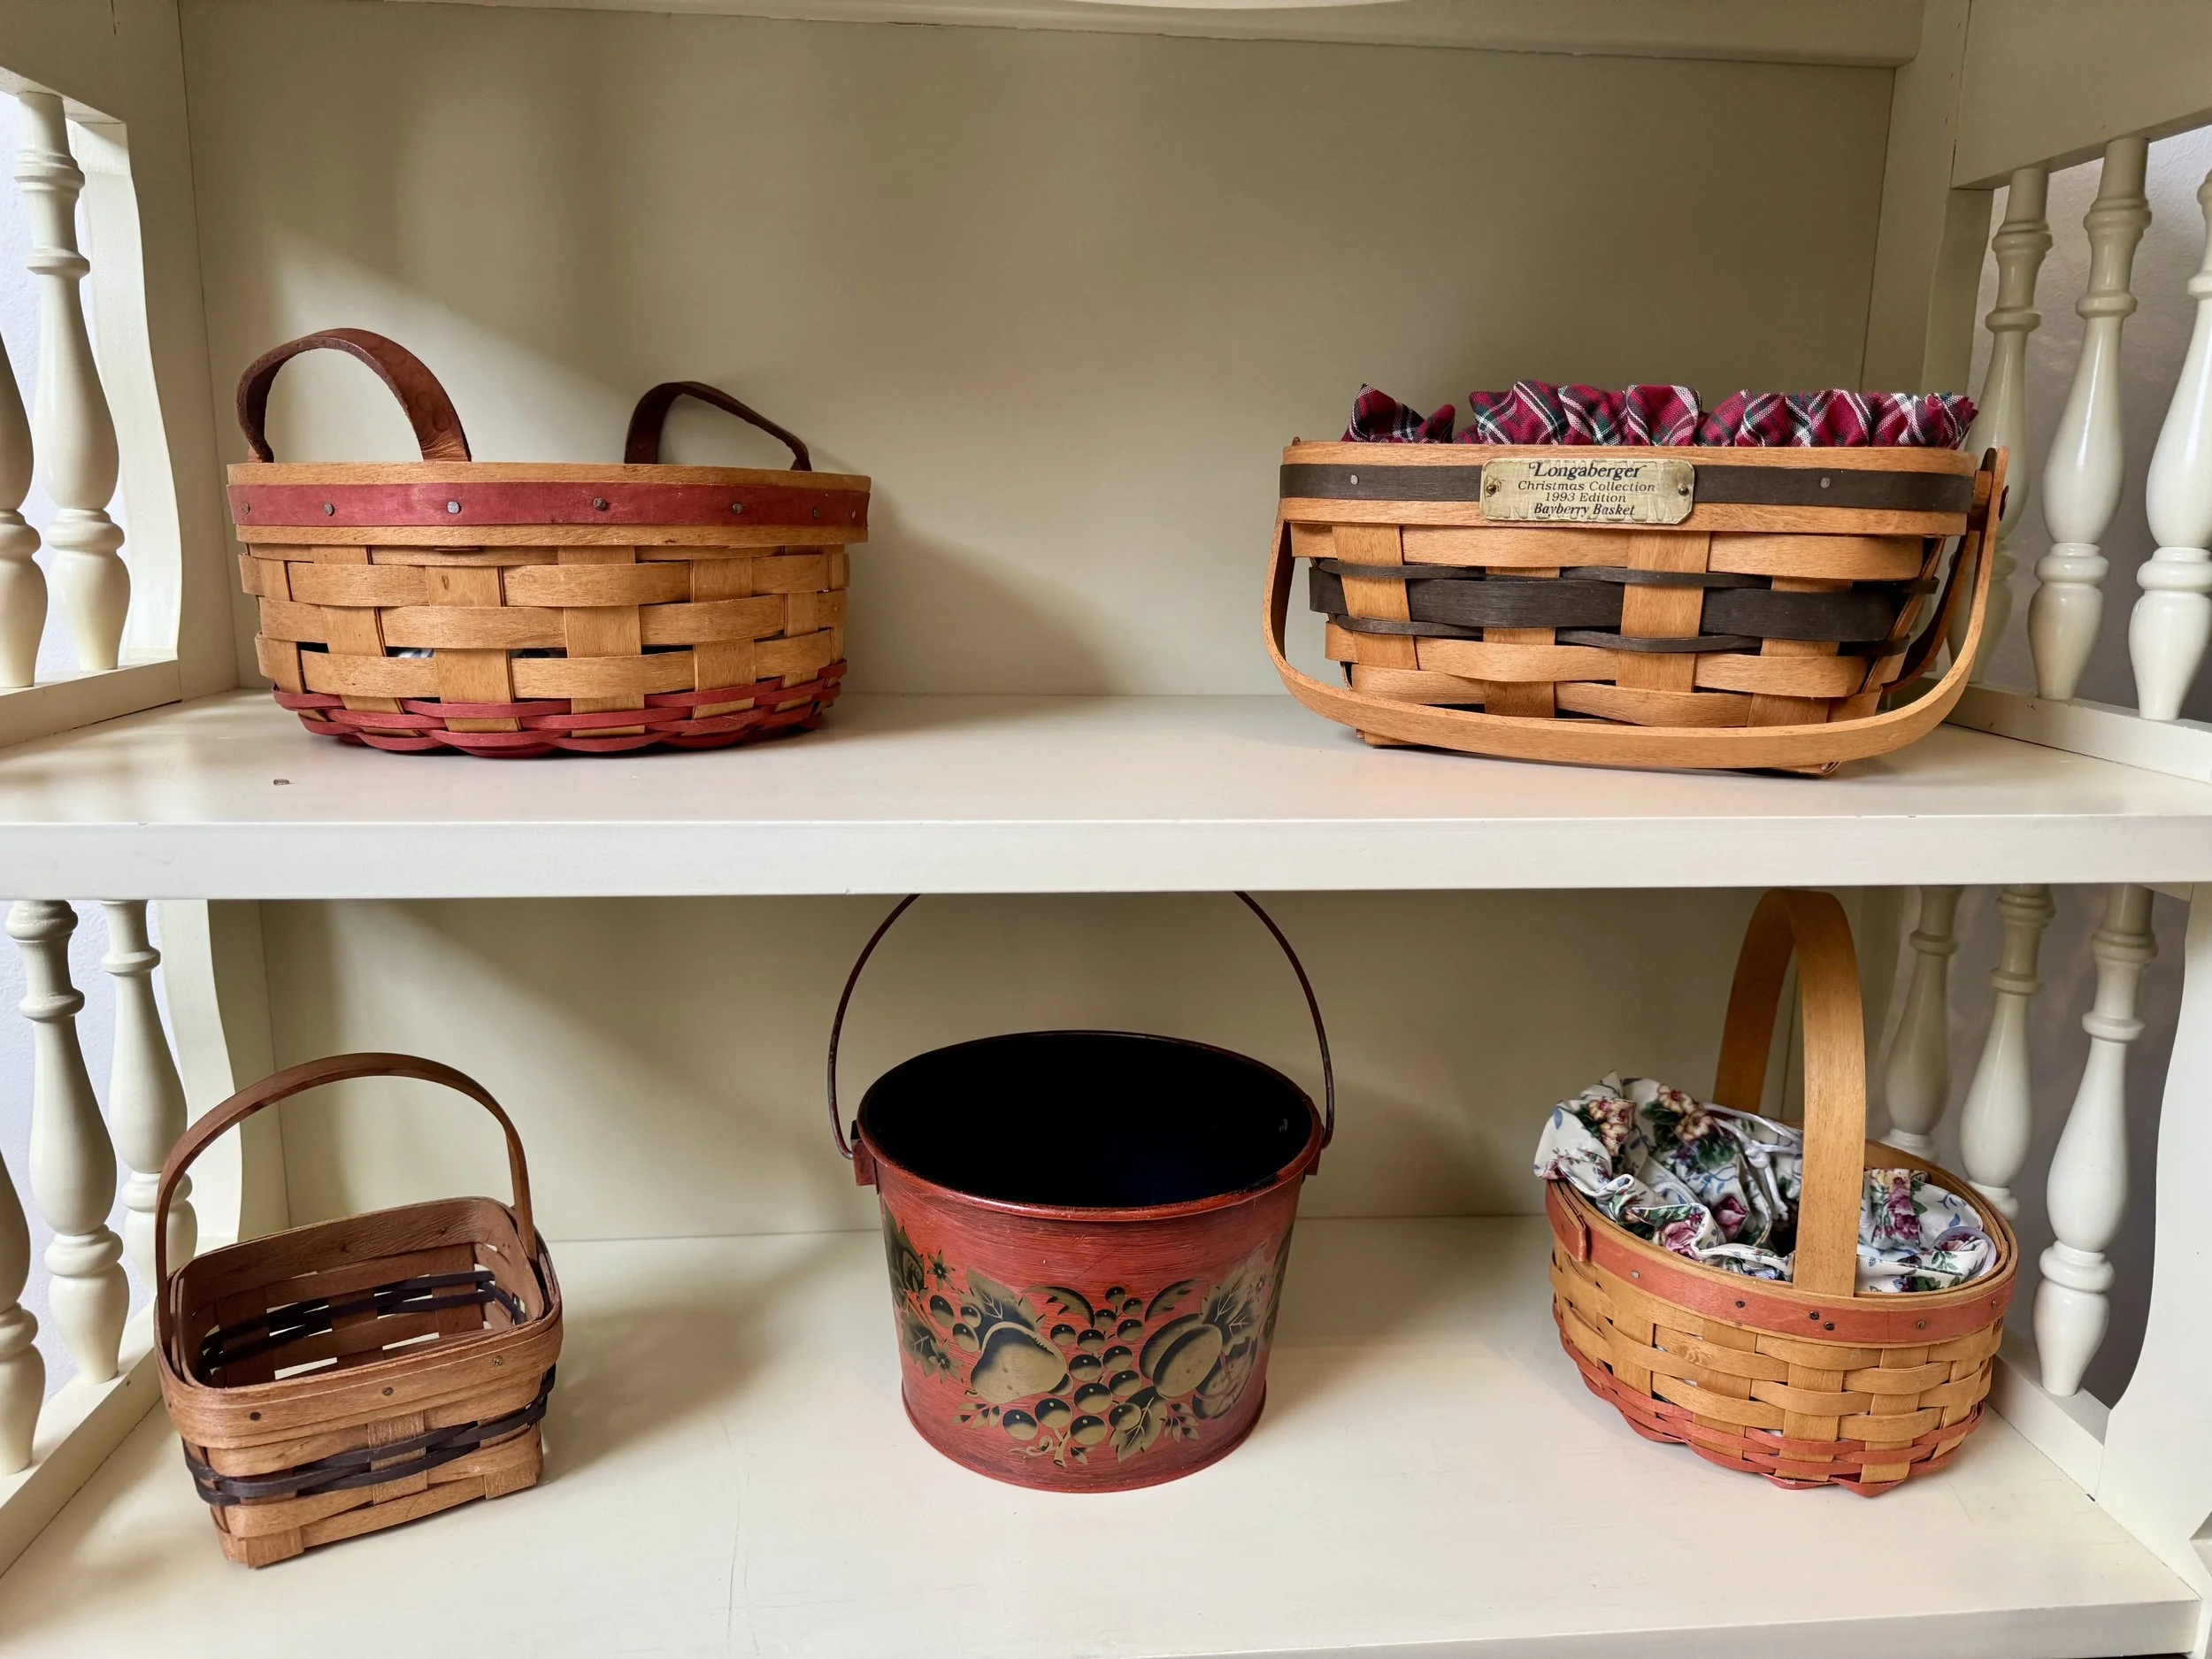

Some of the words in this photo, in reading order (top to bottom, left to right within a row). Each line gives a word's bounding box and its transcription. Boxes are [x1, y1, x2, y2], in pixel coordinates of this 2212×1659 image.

[1528, 461, 1647, 481] Longaberger
[1517, 480, 1585, 491] Christmas
[1589, 480, 1655, 492] Collection
[1546, 492, 1575, 502] 1993
[1579, 492, 1626, 503] Edition
[1533, 503, 1589, 517] Bayberry
[1593, 503, 1635, 516] Basket
